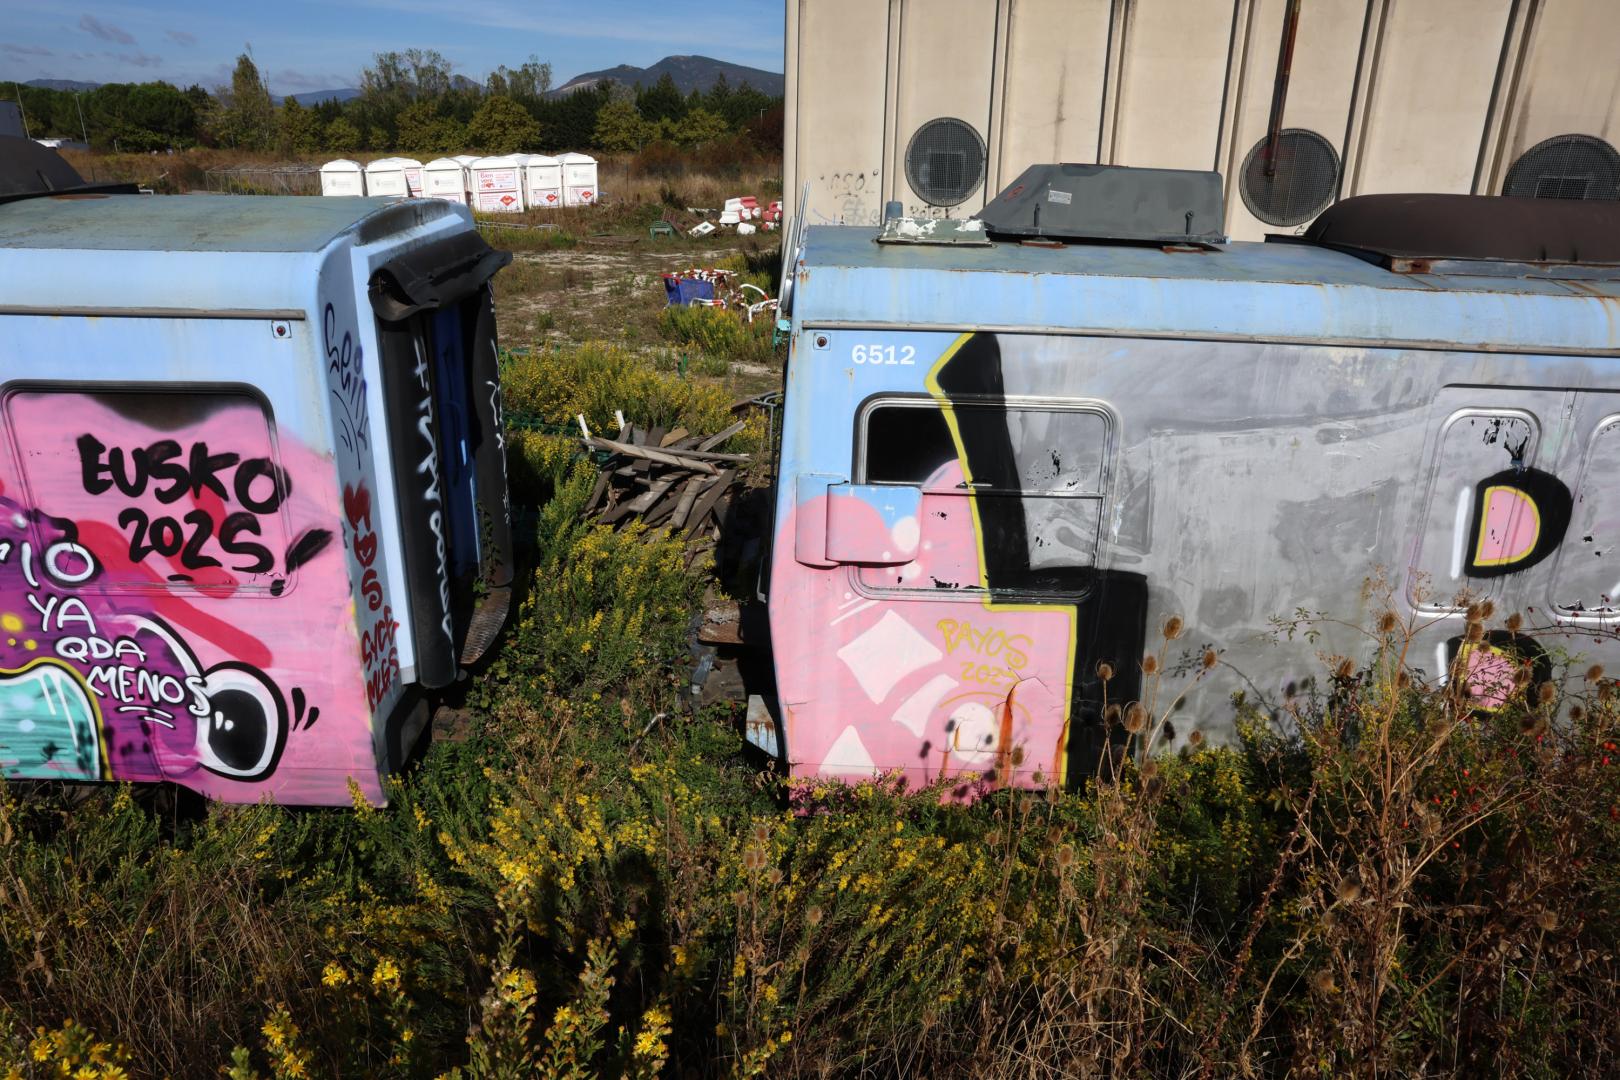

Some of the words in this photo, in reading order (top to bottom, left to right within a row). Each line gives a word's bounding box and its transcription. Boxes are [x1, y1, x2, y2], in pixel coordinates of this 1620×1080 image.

[851, 344, 916, 365] 6512
[77, 433, 293, 514] EUSKO
[28, 593, 97, 634] YA
[56, 636, 147, 662] QDA
[936, 618, 1034, 670] PAYOS
[86, 664, 211, 716] MENOS
